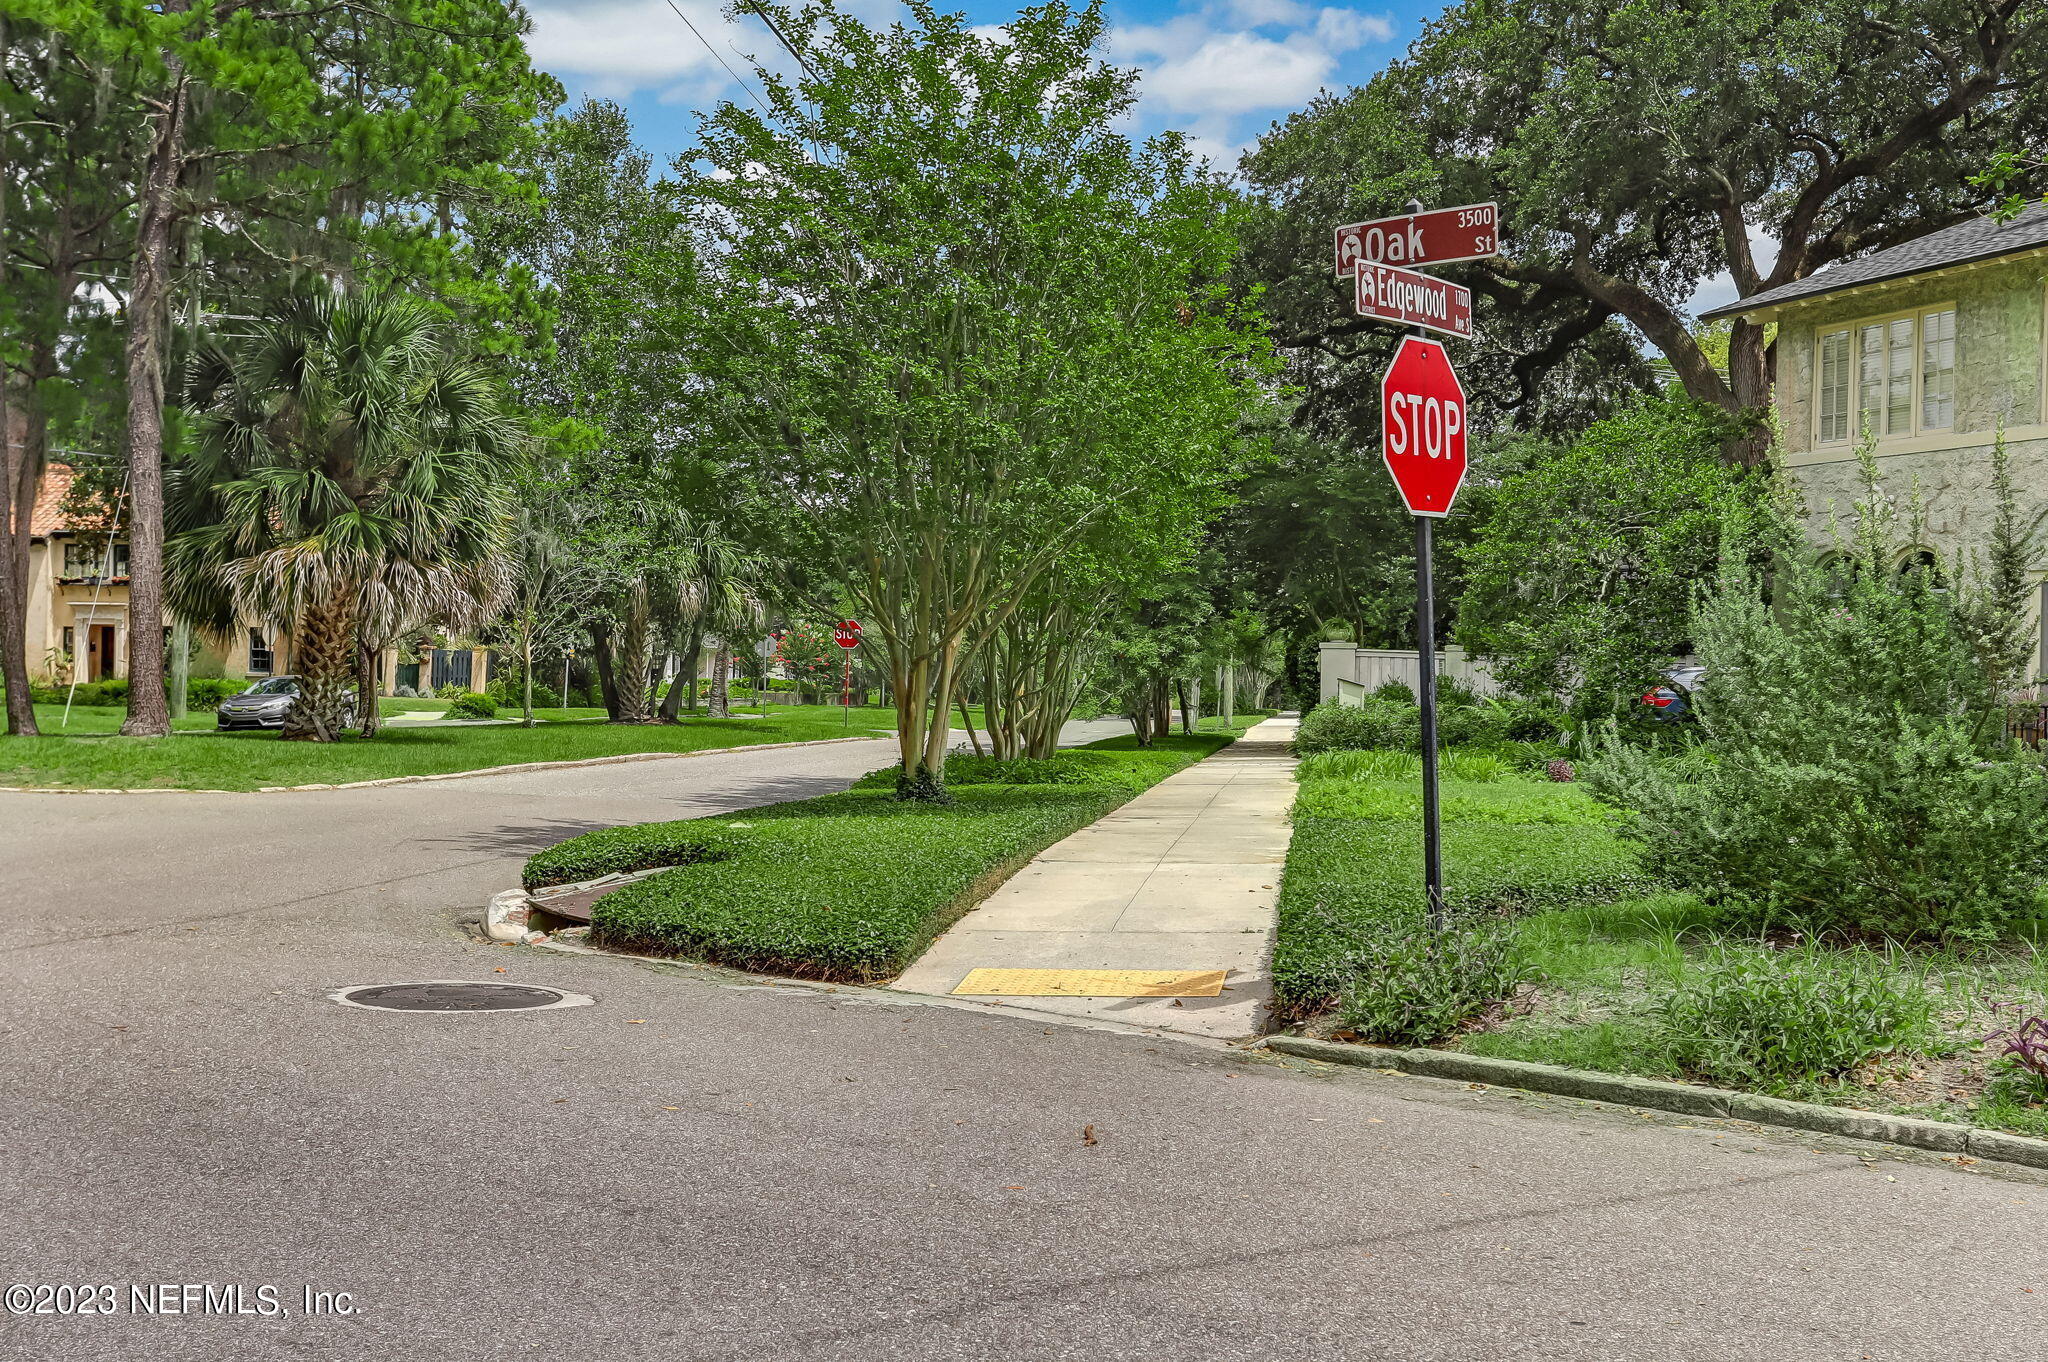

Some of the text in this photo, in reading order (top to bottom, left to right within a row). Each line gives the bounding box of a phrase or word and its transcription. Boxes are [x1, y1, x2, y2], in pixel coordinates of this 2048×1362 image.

[1457, 208, 1492, 228] 3500
[1365, 221, 1493, 263] Oak St
[1377, 267, 1447, 320] Edgewood
[1455, 289, 1469, 308] 1700
[1389, 391, 1461, 460] STOP
